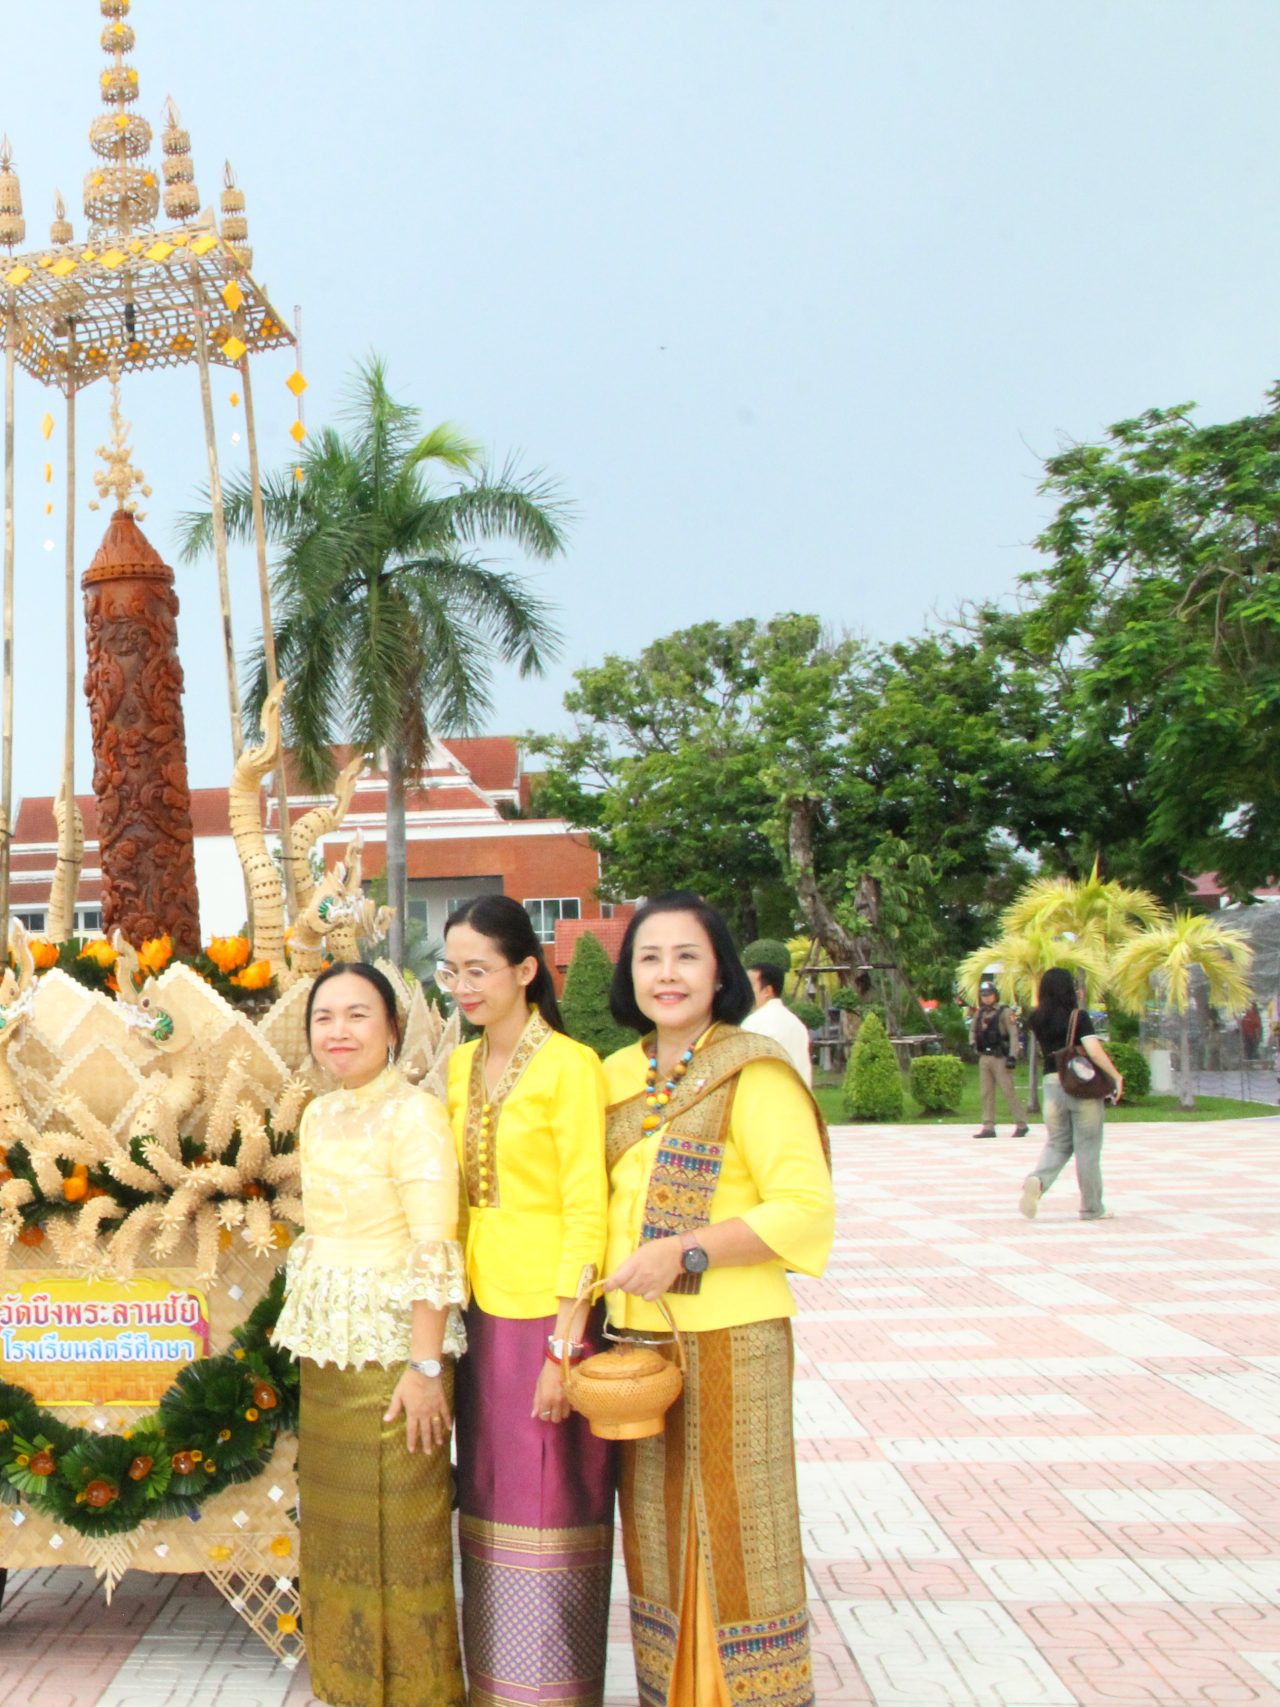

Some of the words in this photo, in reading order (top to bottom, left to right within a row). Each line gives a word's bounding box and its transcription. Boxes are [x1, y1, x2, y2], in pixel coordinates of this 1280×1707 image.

[2, 1331, 195, 1361] โรงเรียนสตรีศึกษา
